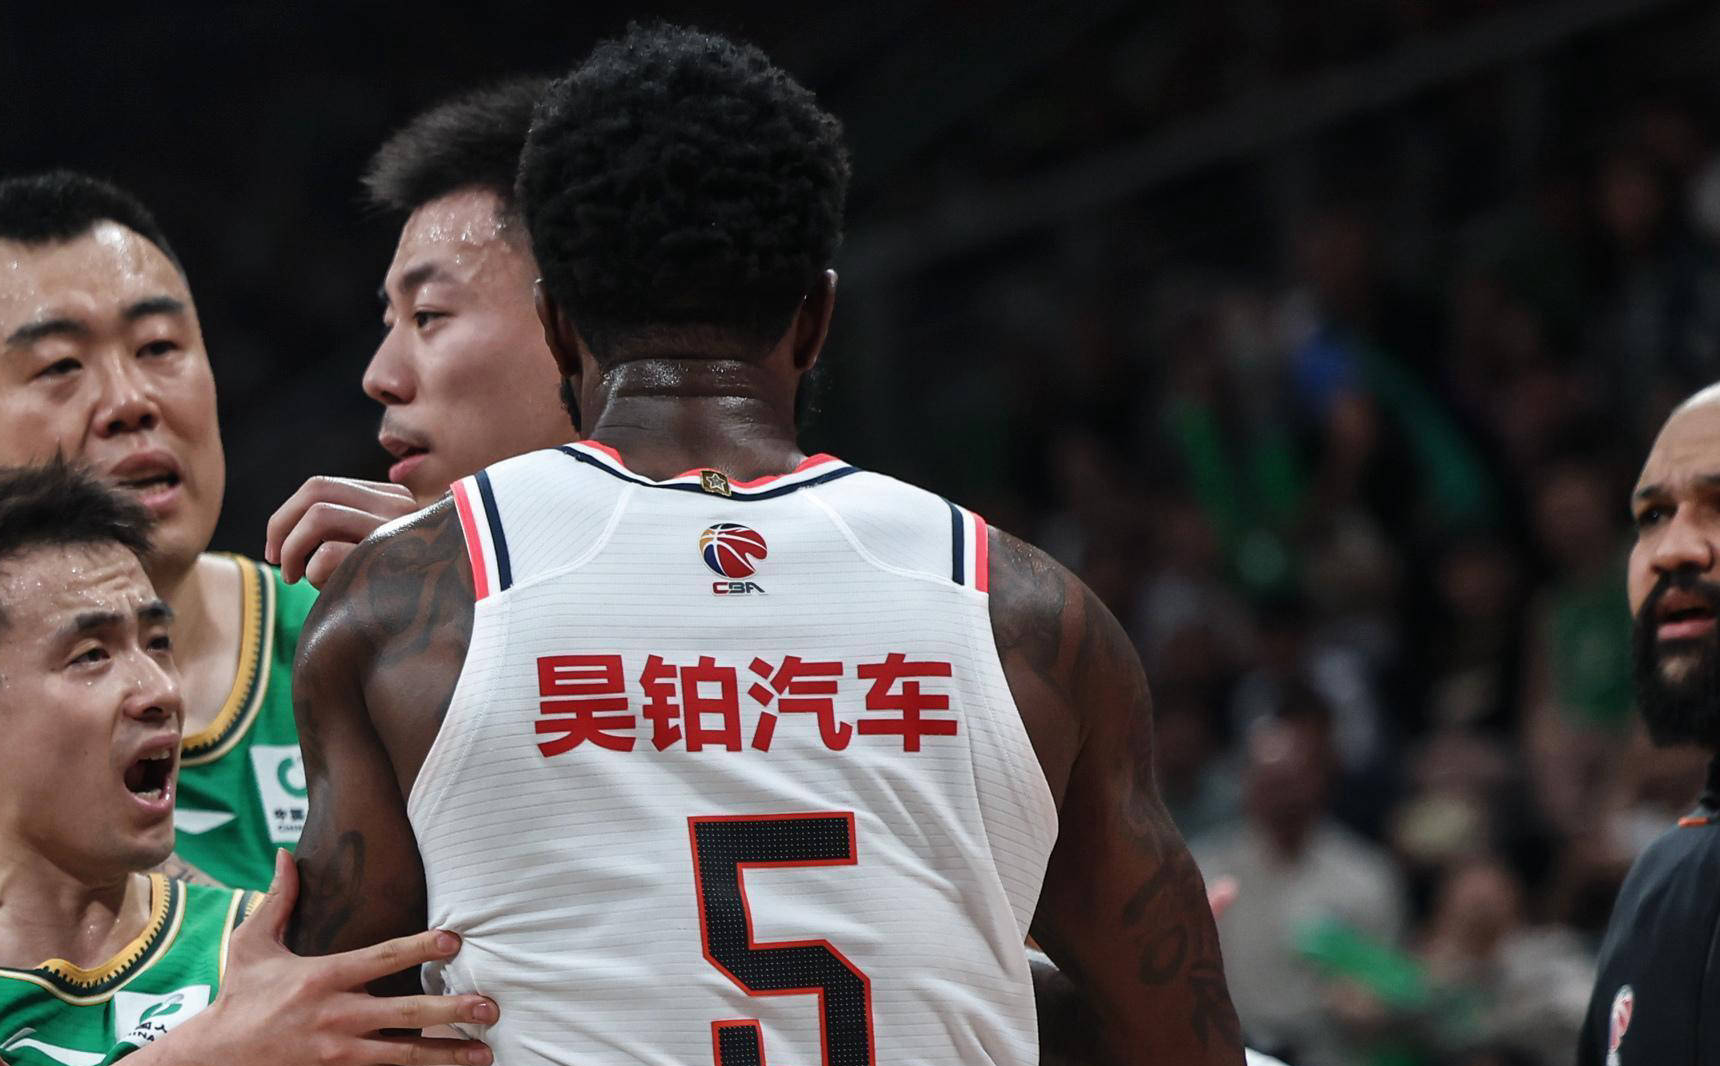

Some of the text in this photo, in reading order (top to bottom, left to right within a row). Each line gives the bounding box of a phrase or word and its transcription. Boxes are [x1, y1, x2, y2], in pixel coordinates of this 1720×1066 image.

[712, 581, 766, 595] CBA
[535, 652, 958, 758] 昊铂汽车
